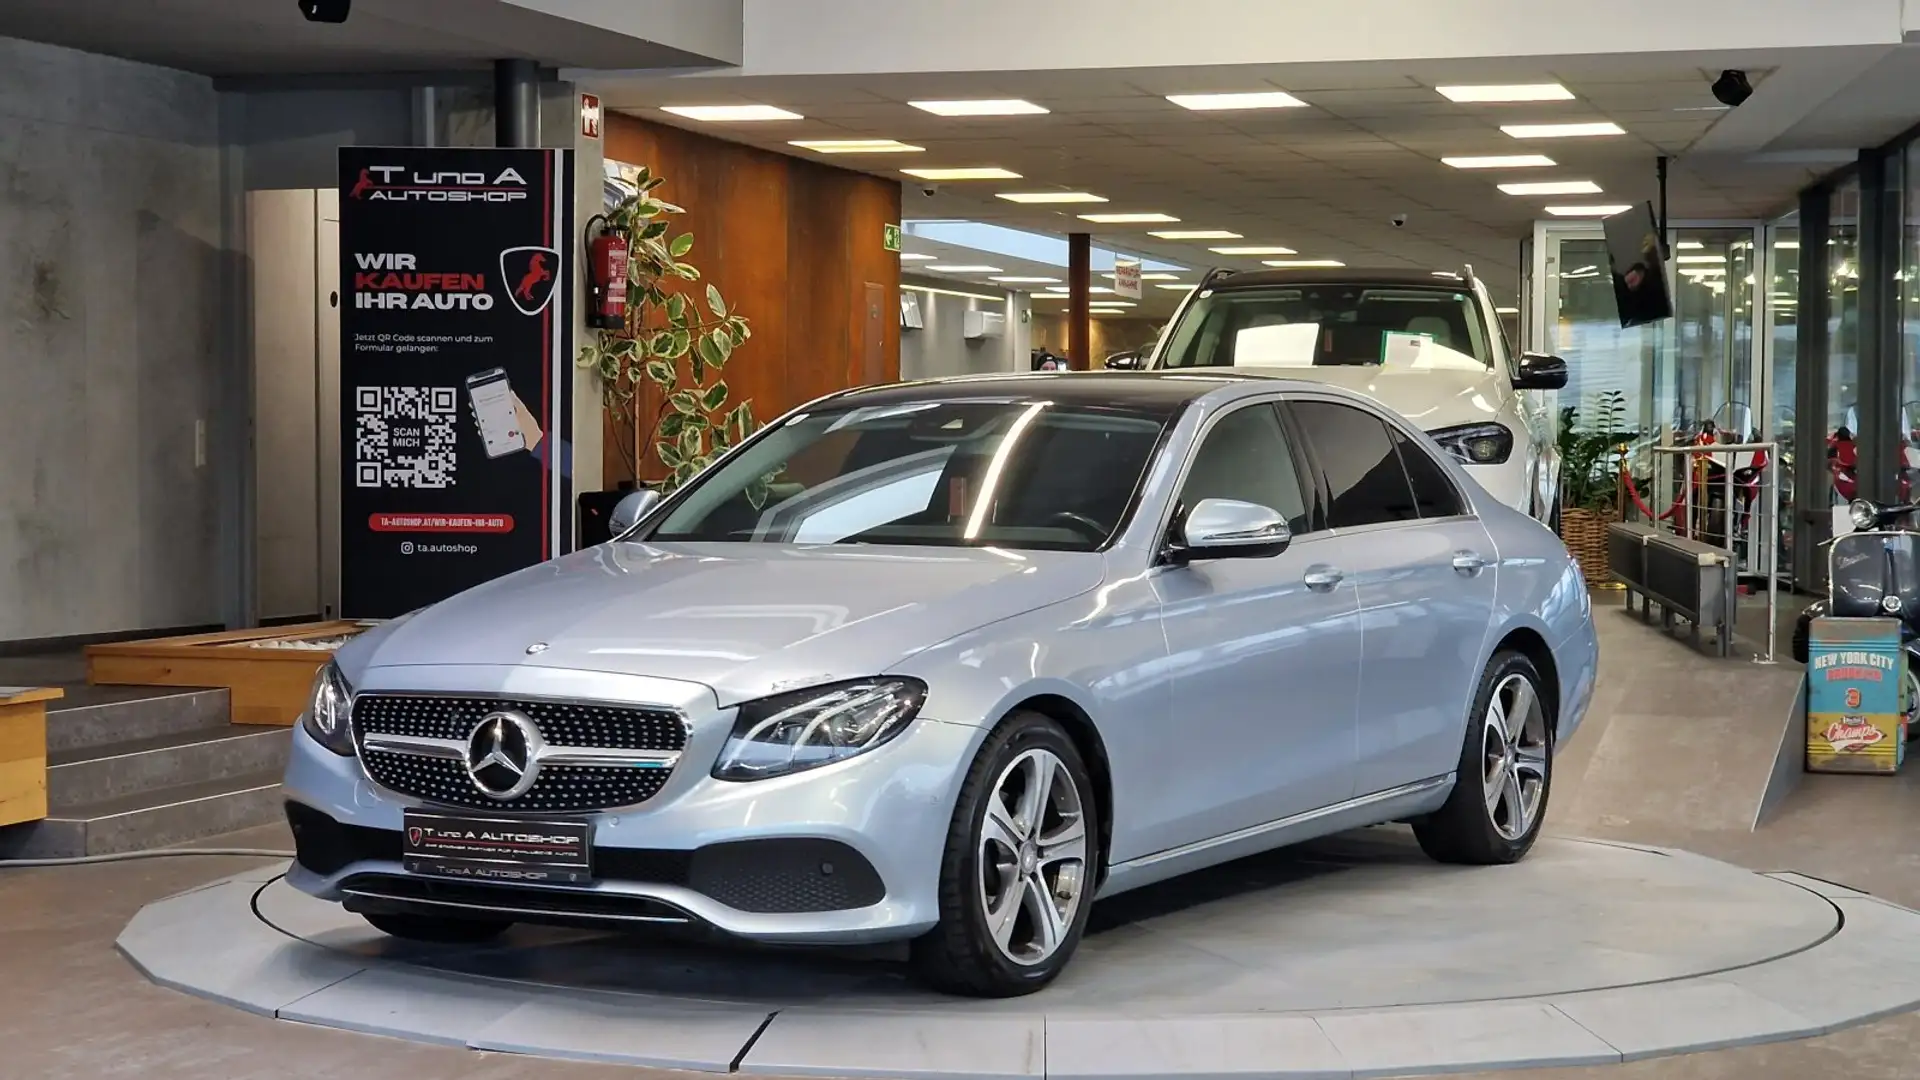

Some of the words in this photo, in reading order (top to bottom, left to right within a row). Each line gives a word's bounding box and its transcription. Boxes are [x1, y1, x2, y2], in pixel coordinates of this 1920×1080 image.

[369, 165, 405, 184] T
[492, 167, 527, 185] A
[369, 190, 527, 202] AUTOSHOP
[355, 253, 416, 270] WIR
[355, 273, 484, 291] KAUFEN
[355, 293, 408, 310] IHR
[411, 293, 494, 311] AUTO
[354, 333, 376, 342] Jetzt
[377, 333, 392, 343] QR
[392, 333, 415, 342] Code
[416, 335, 454, 343] scannen
[454, 334, 473, 343] und
[473, 335, 494, 343] zum
[354, 343, 394, 352] Formular
[393, 427, 420, 437] SCAN
[392, 437, 420, 447] MICH
[417, 544, 478, 555] ta.autoshop
[1814, 652, 1838, 670] NEW
[1840, 651, 1868, 667] YORK
[1869, 652, 1895, 671] CITY
[423, 827, 435, 836] T
[464, 830, 476, 839] A
[480, 831, 580, 844] AUTOSHOP
[475, 868, 548, 880] AUTOSHOP
